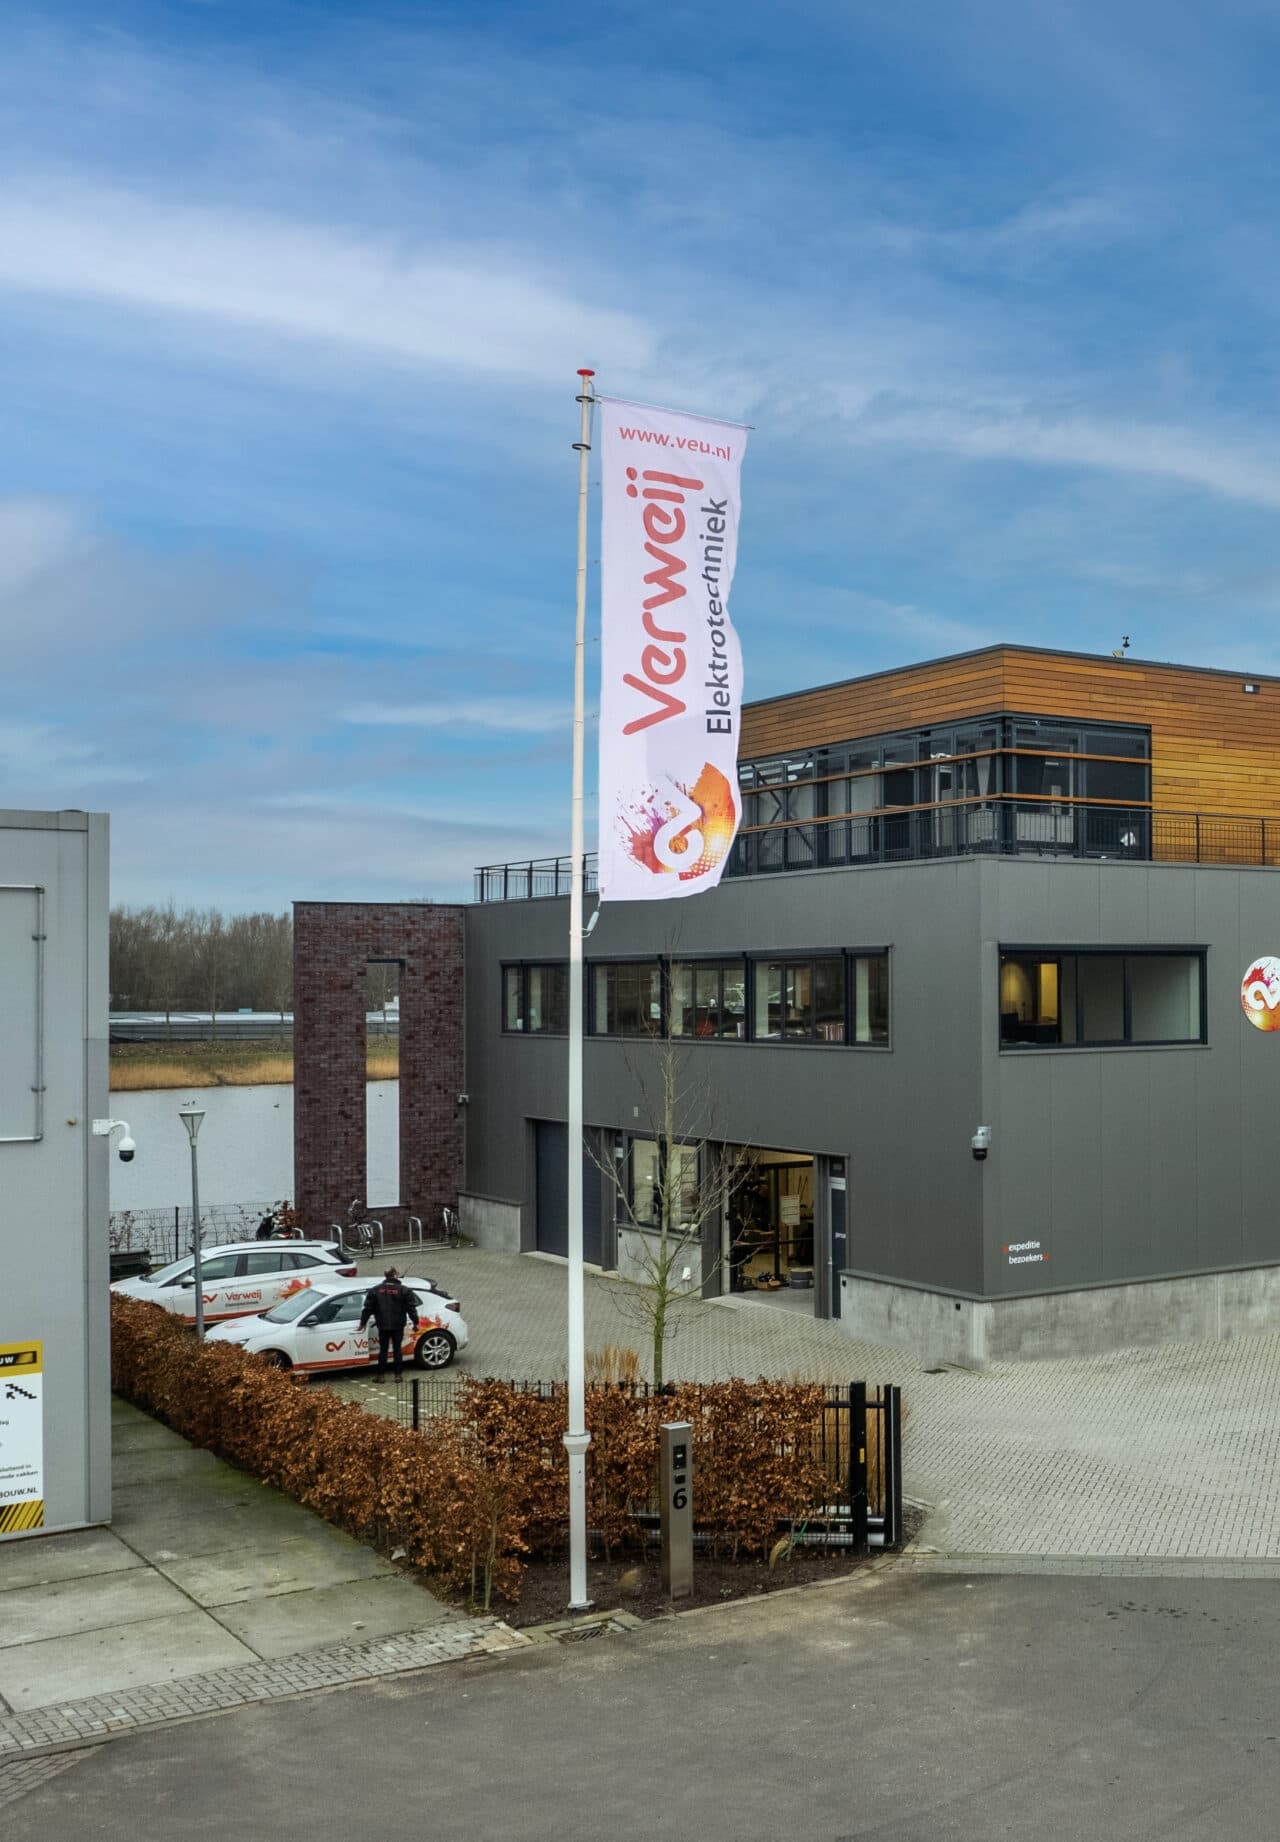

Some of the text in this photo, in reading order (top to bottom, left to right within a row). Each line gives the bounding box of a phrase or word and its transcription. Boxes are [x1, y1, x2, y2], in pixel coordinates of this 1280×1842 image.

[619, 426, 731, 462] www.veu.nl
[622, 466, 704, 735] Verweij
[699, 497, 732, 734] Elektrotechniek
[1008, 1240, 1040, 1252] expeditie
[1008, 1253, 1043, 1264] bezoekers
[224, 1289, 262, 1301] Verweij
[672, 1487, 688, 1510] 6
